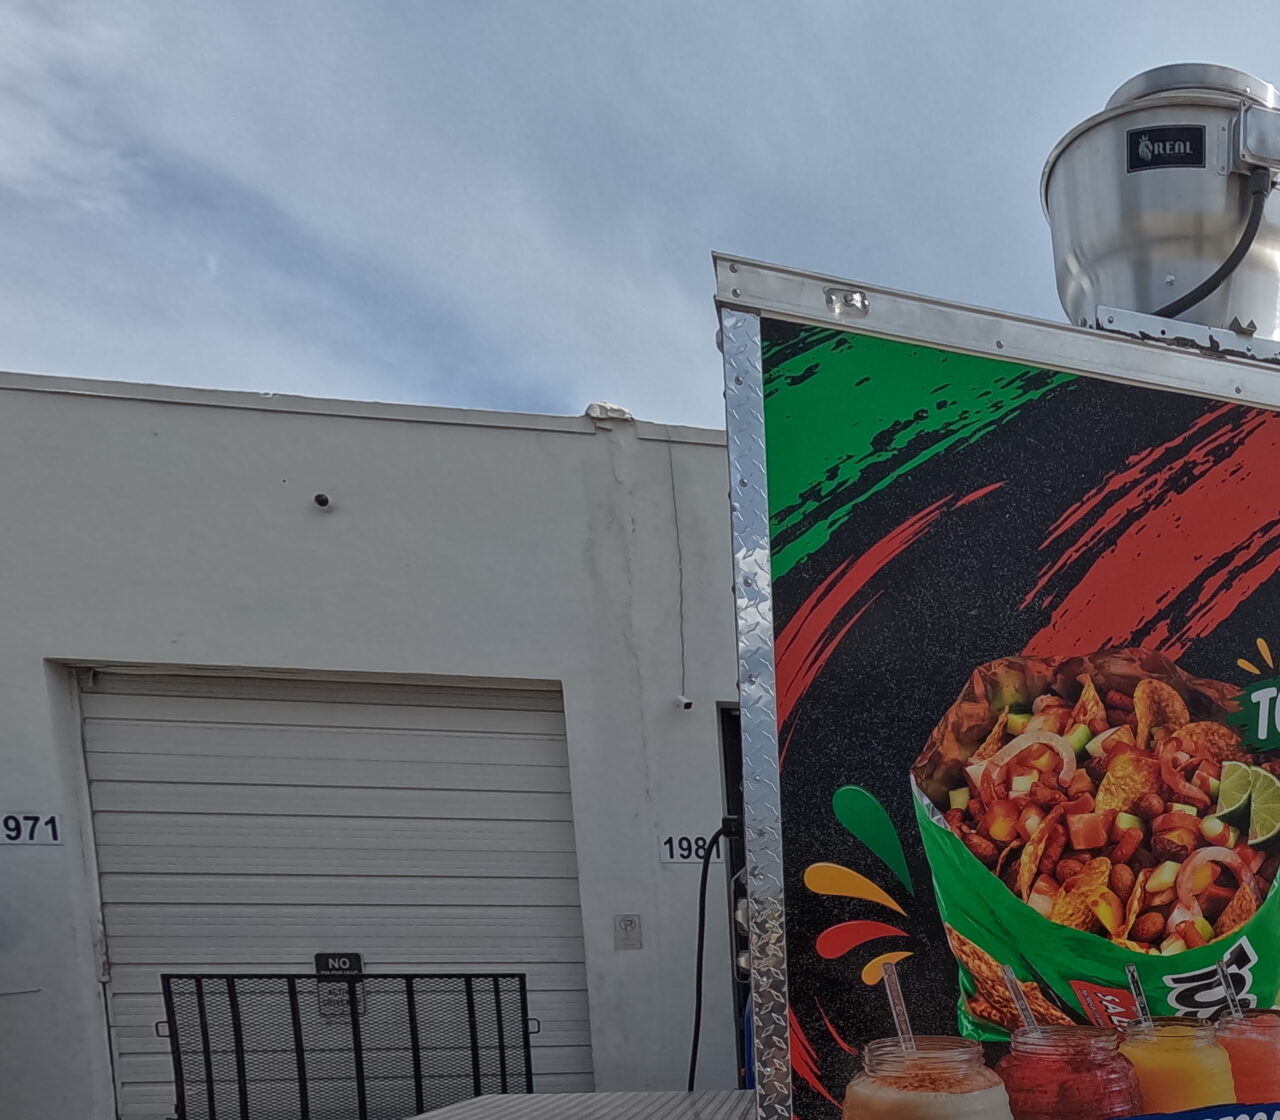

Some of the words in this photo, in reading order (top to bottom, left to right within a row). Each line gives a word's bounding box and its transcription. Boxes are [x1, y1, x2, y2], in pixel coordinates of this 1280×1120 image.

[2, 814, 59, 841] 971
[663, 836, 721, 860] 1981
[328, 957, 350, 969] NO
